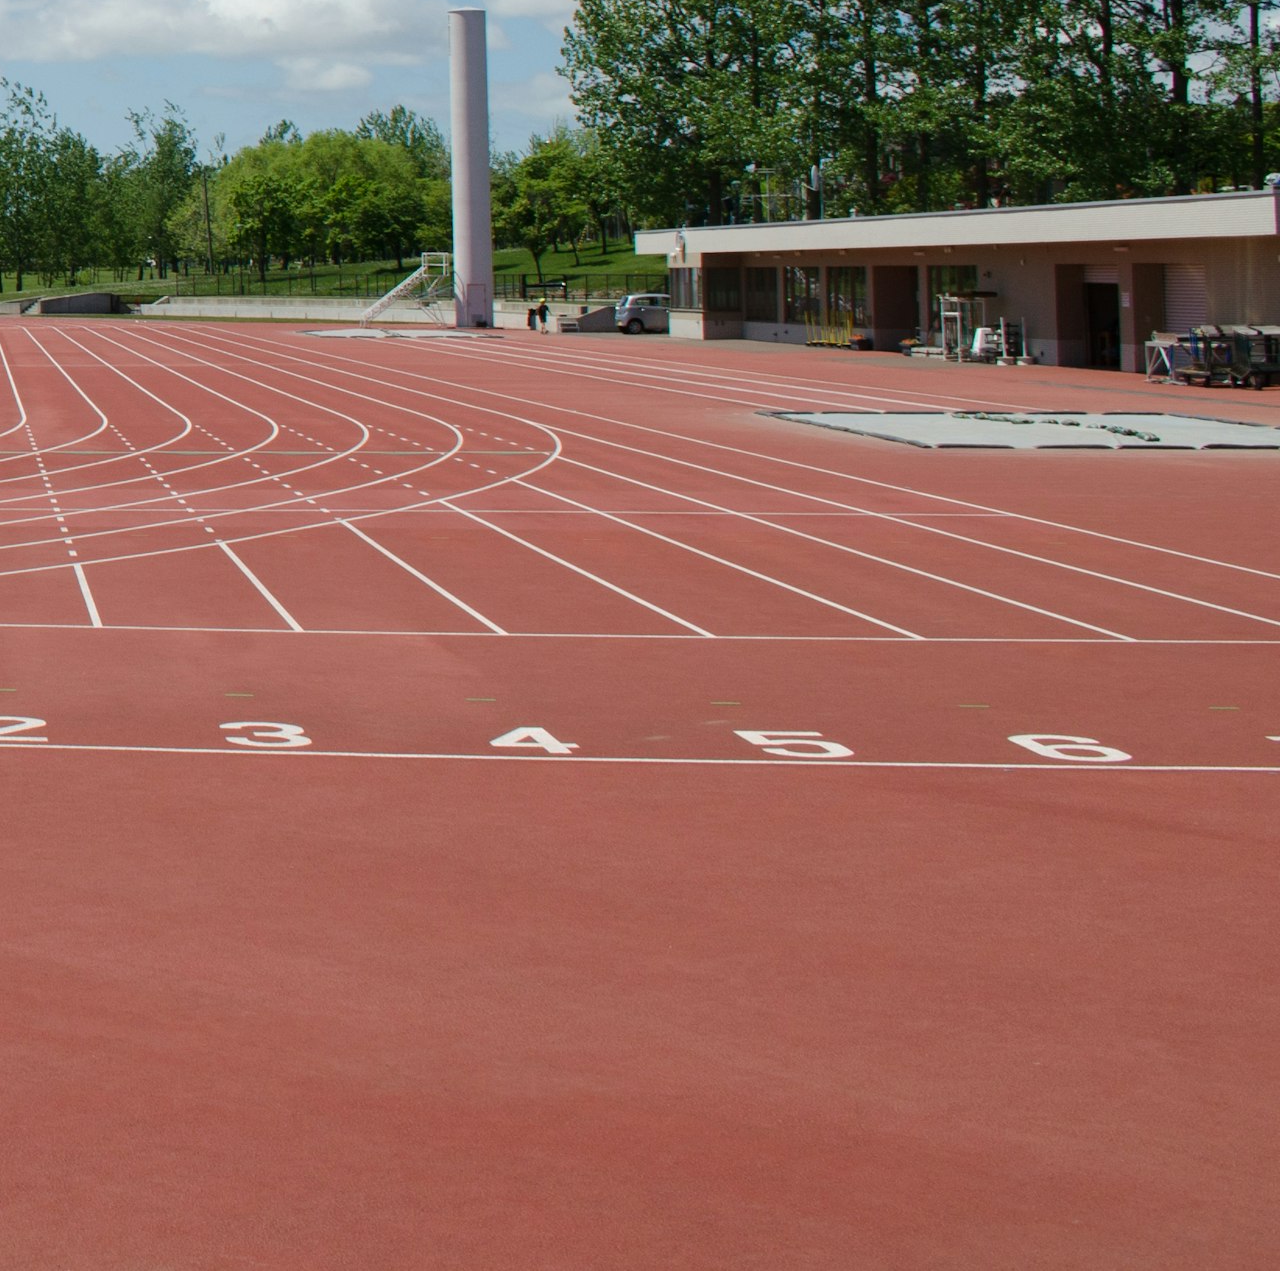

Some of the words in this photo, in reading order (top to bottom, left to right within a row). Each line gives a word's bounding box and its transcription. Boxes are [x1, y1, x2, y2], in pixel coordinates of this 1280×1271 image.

[219, 721, 313, 748] 3
[488, 726, 581, 755] 4
[732, 730, 855, 759] 5
[1006, 734, 1134, 763] 6
